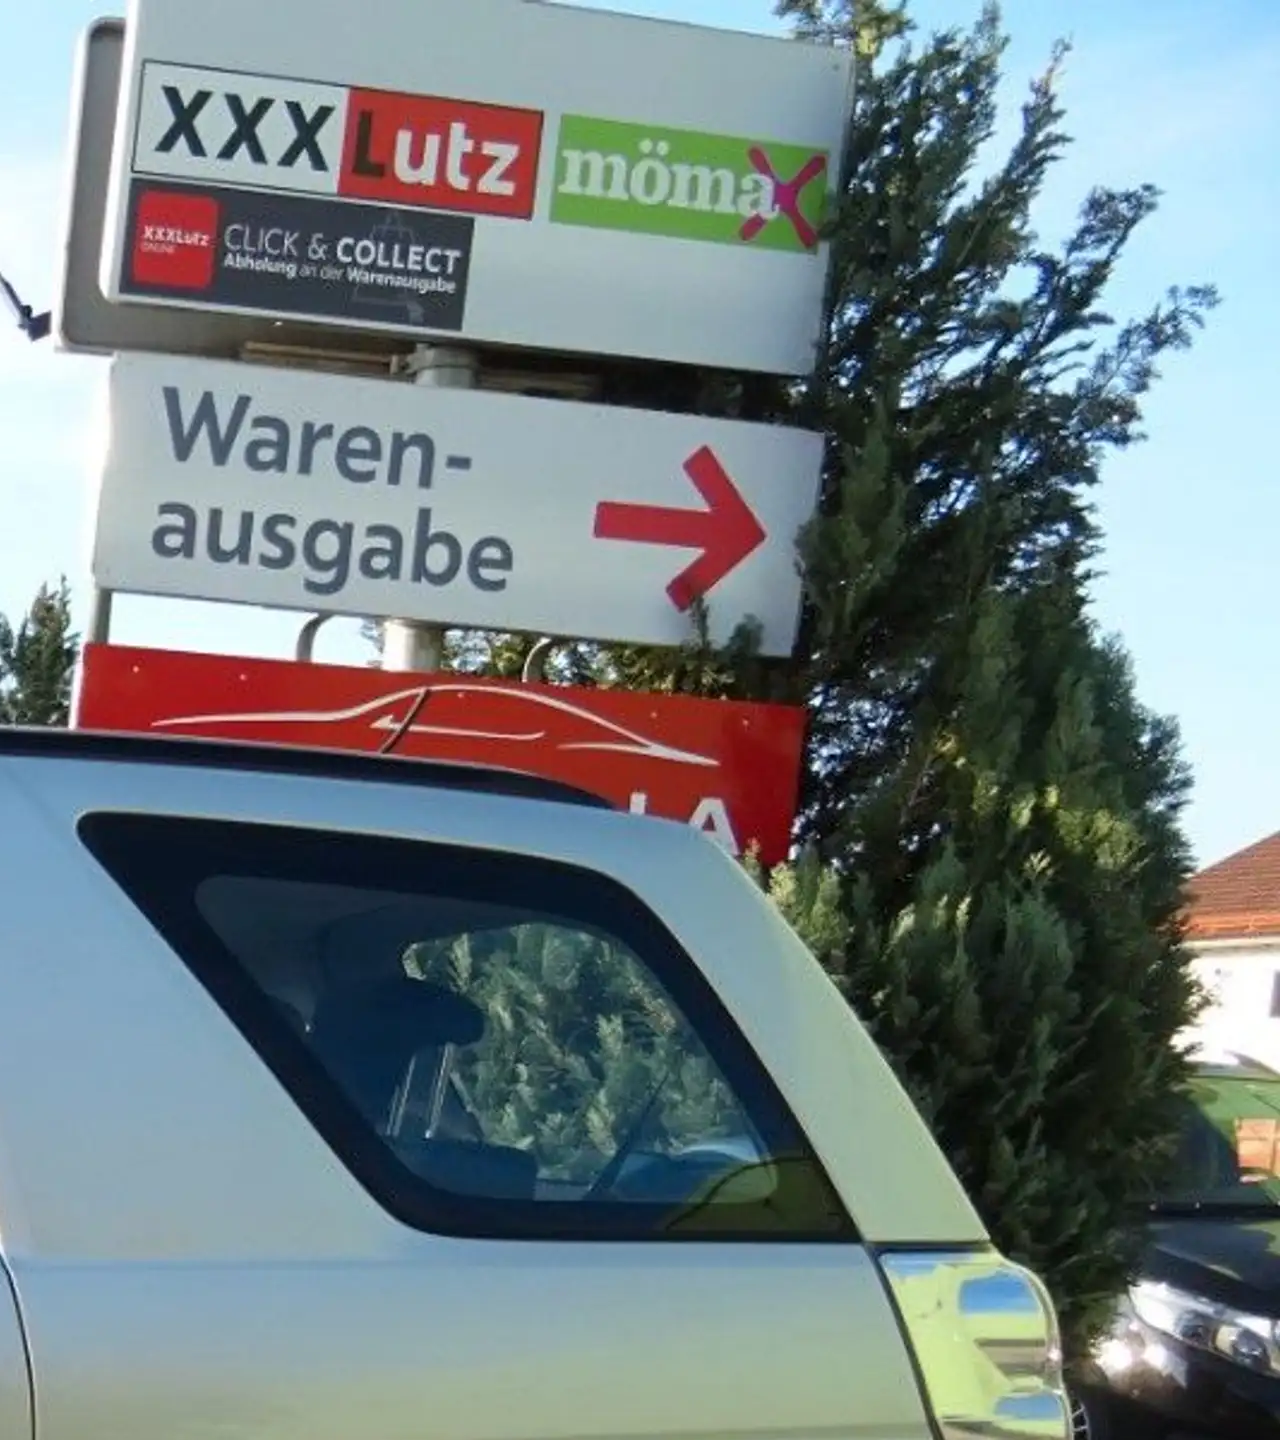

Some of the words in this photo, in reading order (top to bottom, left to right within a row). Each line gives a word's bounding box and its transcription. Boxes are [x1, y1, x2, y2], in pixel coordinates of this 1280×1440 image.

[223, 223, 300, 256] CLICK
[307, 233, 329, 261] &
[336, 236, 462, 275] COLLECT
[223, 252, 297, 278] Abholung
[299, 262, 319, 278] an
[320, 263, 344, 281] der
[345, 266, 457, 295] Warenausgabe
[161, 385, 473, 490] Waren-
[151, 500, 515, 596] ausgabe
